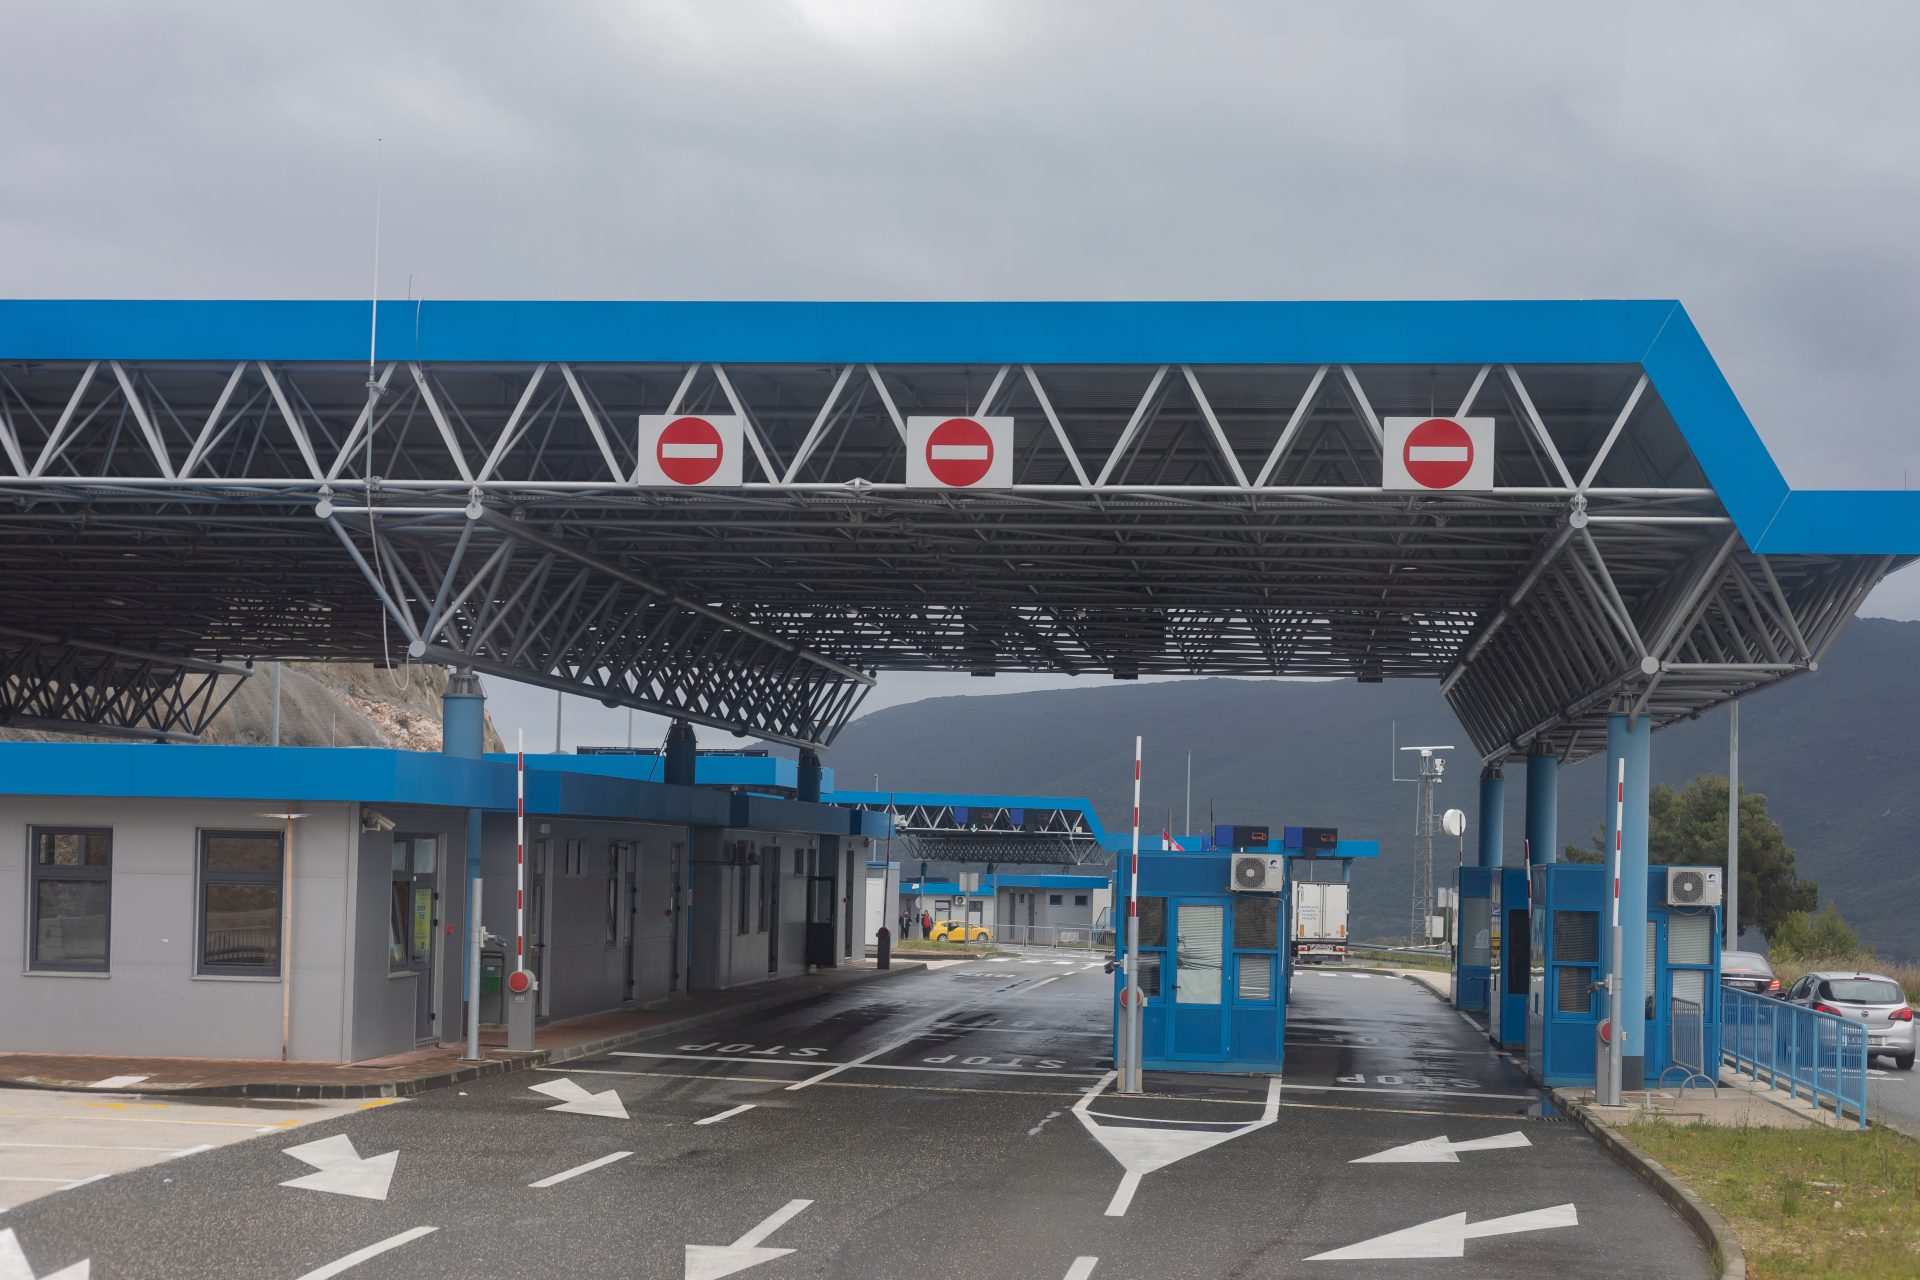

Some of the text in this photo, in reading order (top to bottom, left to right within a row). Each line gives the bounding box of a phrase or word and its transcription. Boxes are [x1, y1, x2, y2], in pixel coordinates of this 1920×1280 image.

[676, 1042, 828, 1057] STOP
[922, 1054, 1067, 1069] STOP
[1336, 1073, 1482, 1088] STOP
